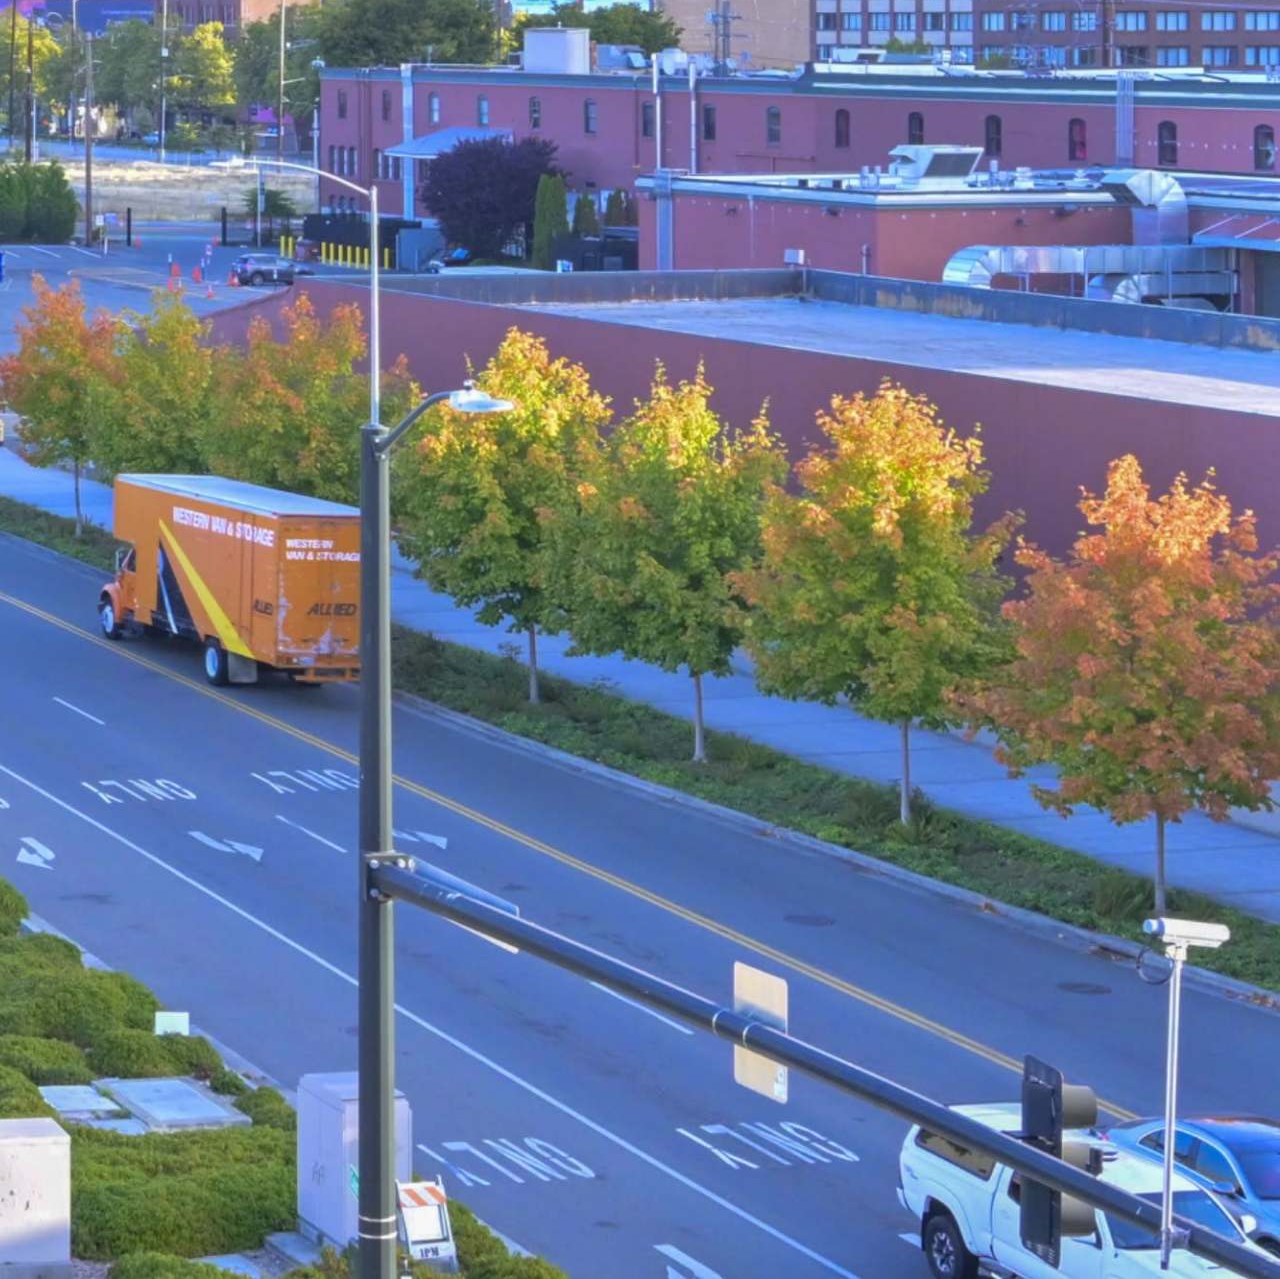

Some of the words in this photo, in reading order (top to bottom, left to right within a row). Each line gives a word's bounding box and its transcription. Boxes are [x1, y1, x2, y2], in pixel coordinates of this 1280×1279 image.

[211, 515, 227, 535] VAN
[227, 522, 233, 537] &
[286, 551, 305, 560] VAN
[307, 551, 314, 560] &
[305, 603, 357, 616] ALLIED
[81, 778, 198, 804] ONLY
[676, 1122, 860, 1169] ONLY
[417, 1137, 596, 1186] ONLY
